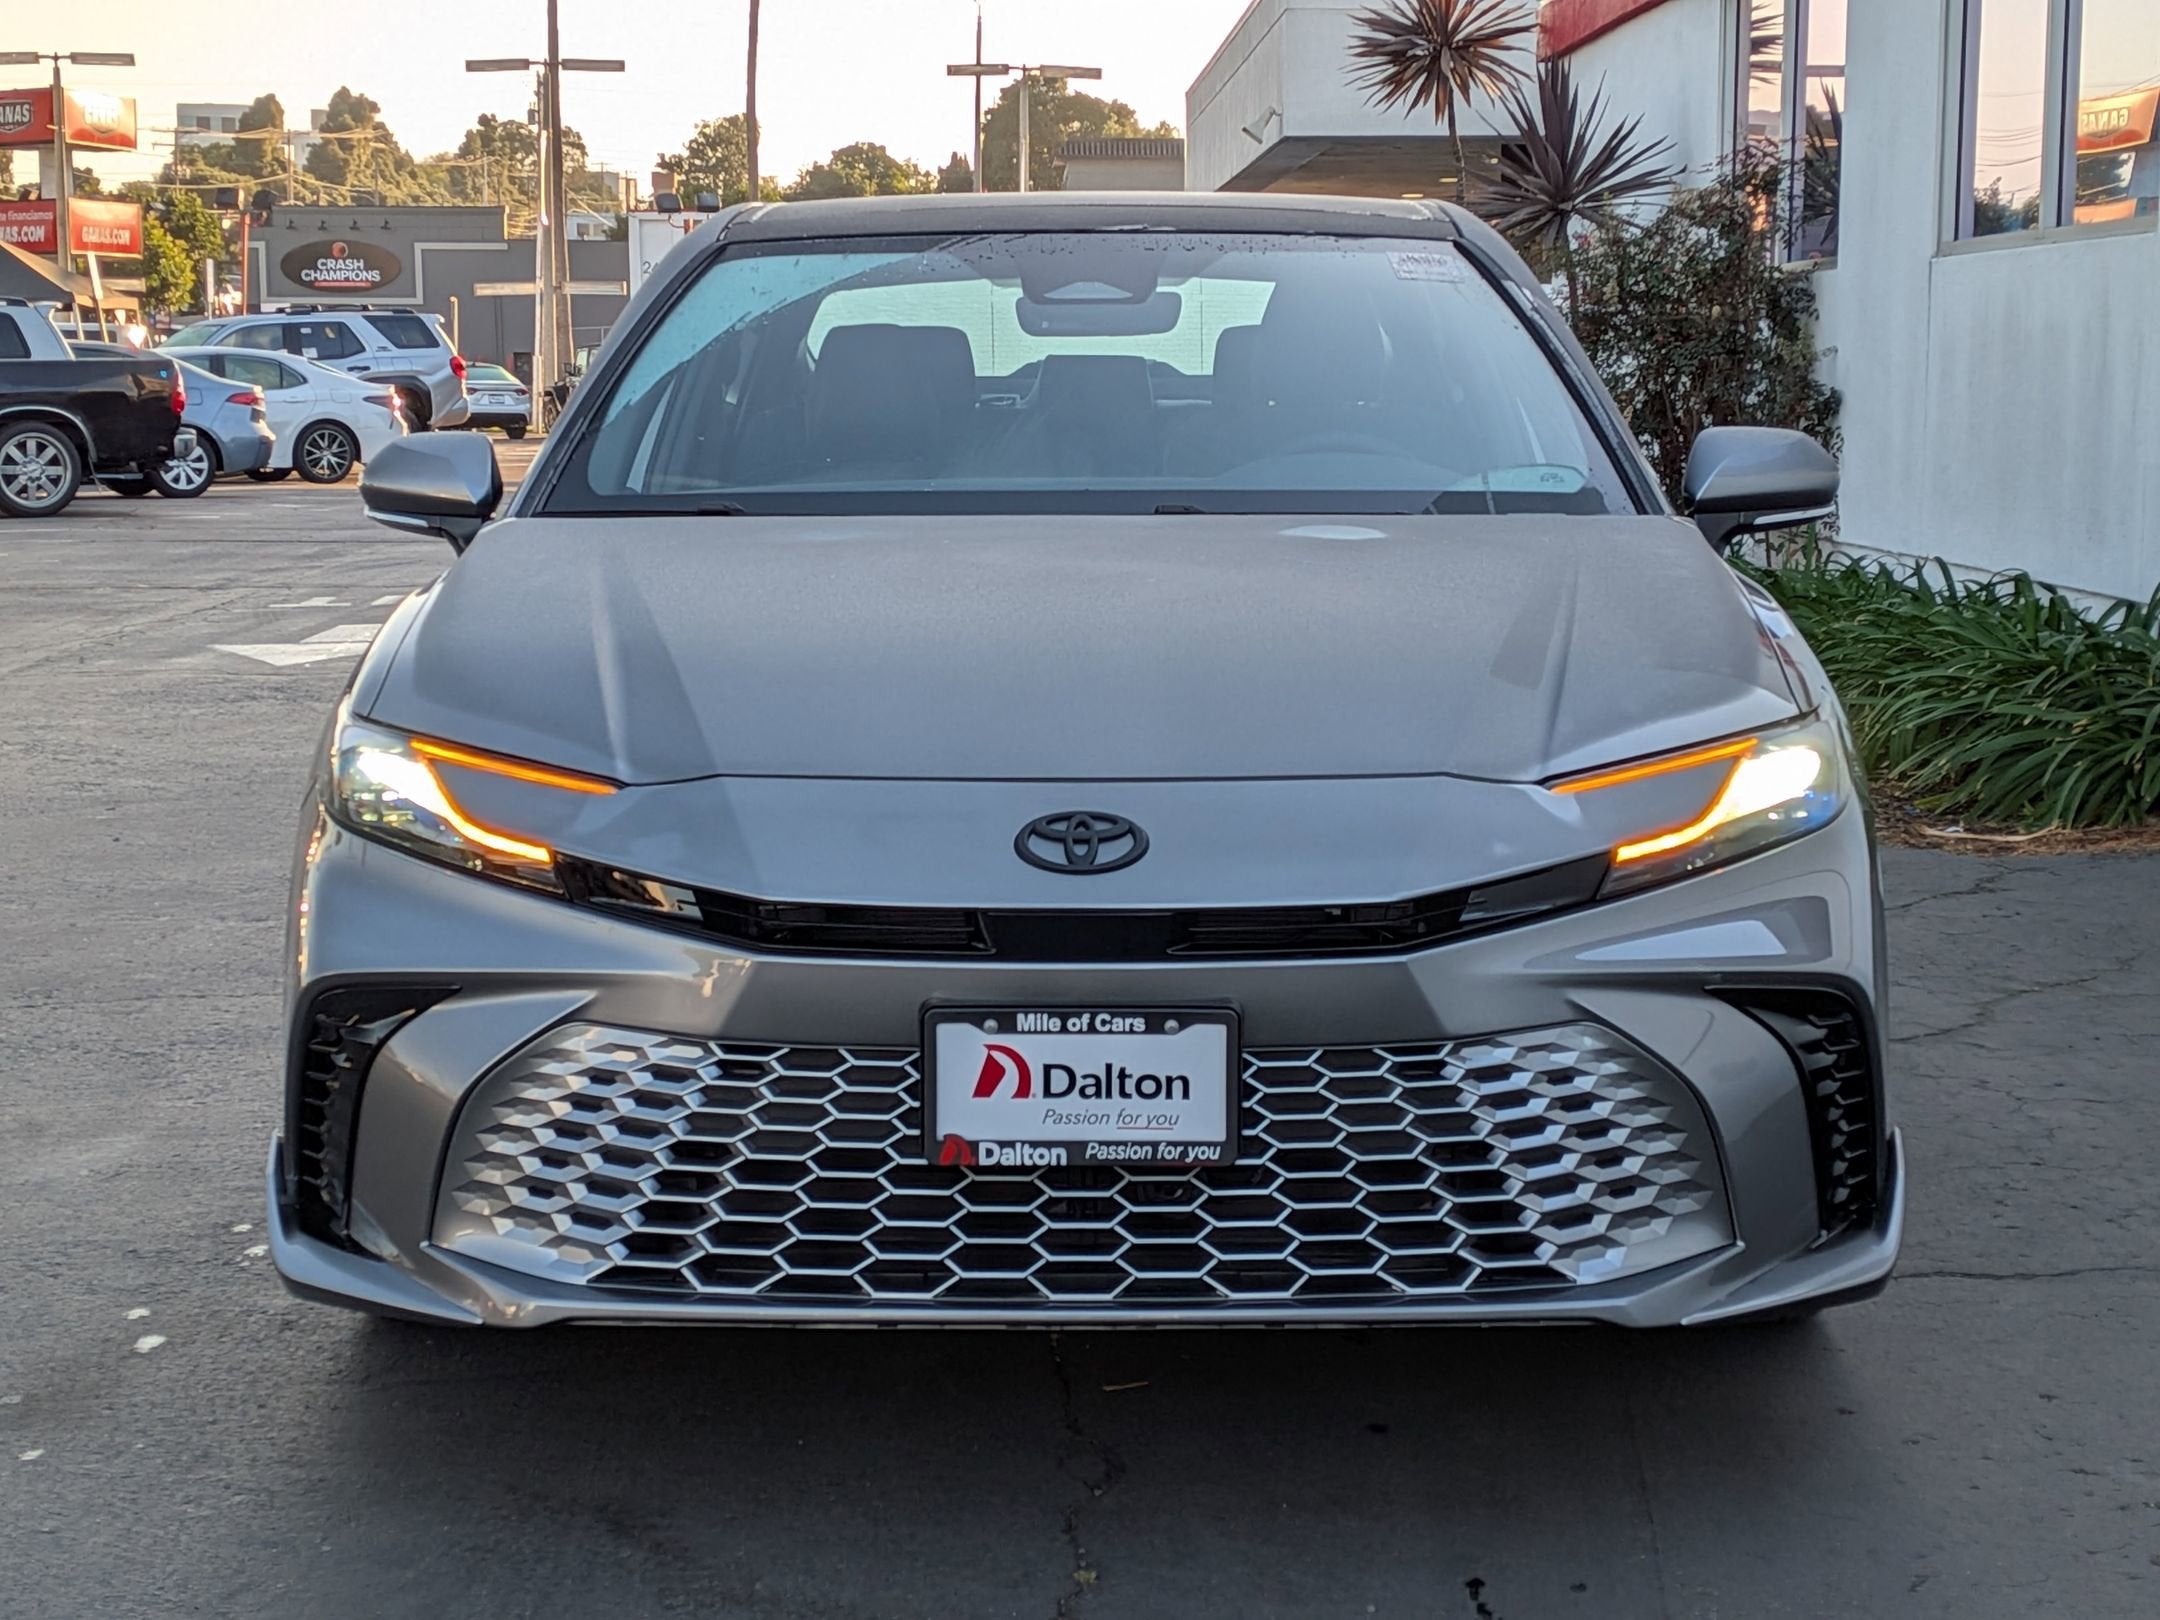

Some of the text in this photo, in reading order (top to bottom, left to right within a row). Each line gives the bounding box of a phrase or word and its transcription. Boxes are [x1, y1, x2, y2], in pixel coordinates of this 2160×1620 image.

[317, 258, 364, 270] CRASH
[300, 269, 381, 282] CHAMPIONS
[1016, 1013, 1146, 1033] Mile of Cars
[1042, 1062, 1190, 1101] Dalton
[1042, 1108, 1180, 1128] Passion for you
[978, 1141, 1068, 1167] Dalton
[1085, 1142, 1221, 1162] Passion for you
